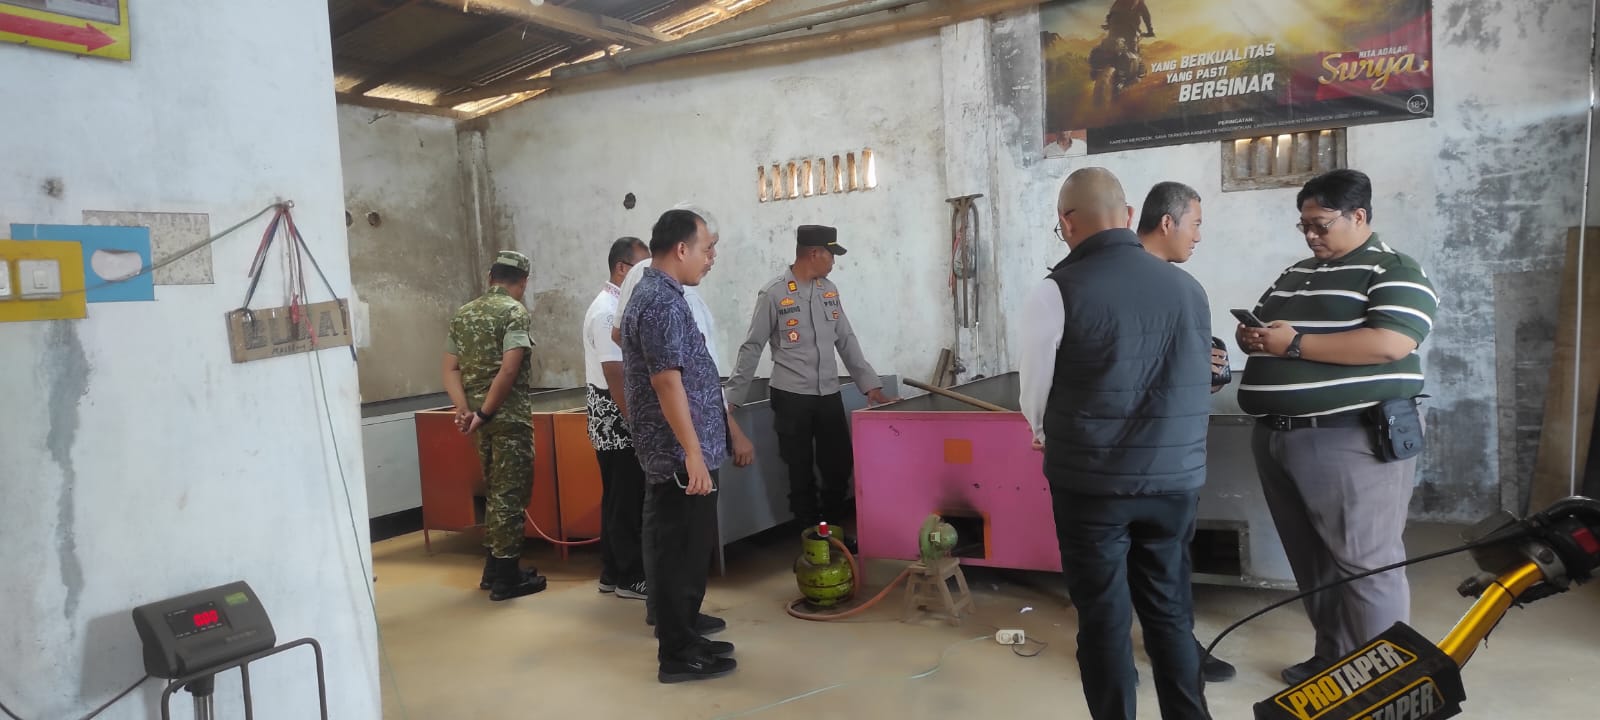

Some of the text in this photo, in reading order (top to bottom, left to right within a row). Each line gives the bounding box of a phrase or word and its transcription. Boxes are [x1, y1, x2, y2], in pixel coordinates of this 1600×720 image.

[1151, 43, 1276, 73] YANG BERKUALITAS
[1377, 45, 1409, 56] ADALAH
[1166, 66, 1228, 84] YANG PASTI
[1178, 72, 1275, 103] BERSINAR
[1318, 53, 1430, 91] Surya
[1287, 643, 1404, 716] PROTAPER
[1365, 682, 1434, 720] TAPER
